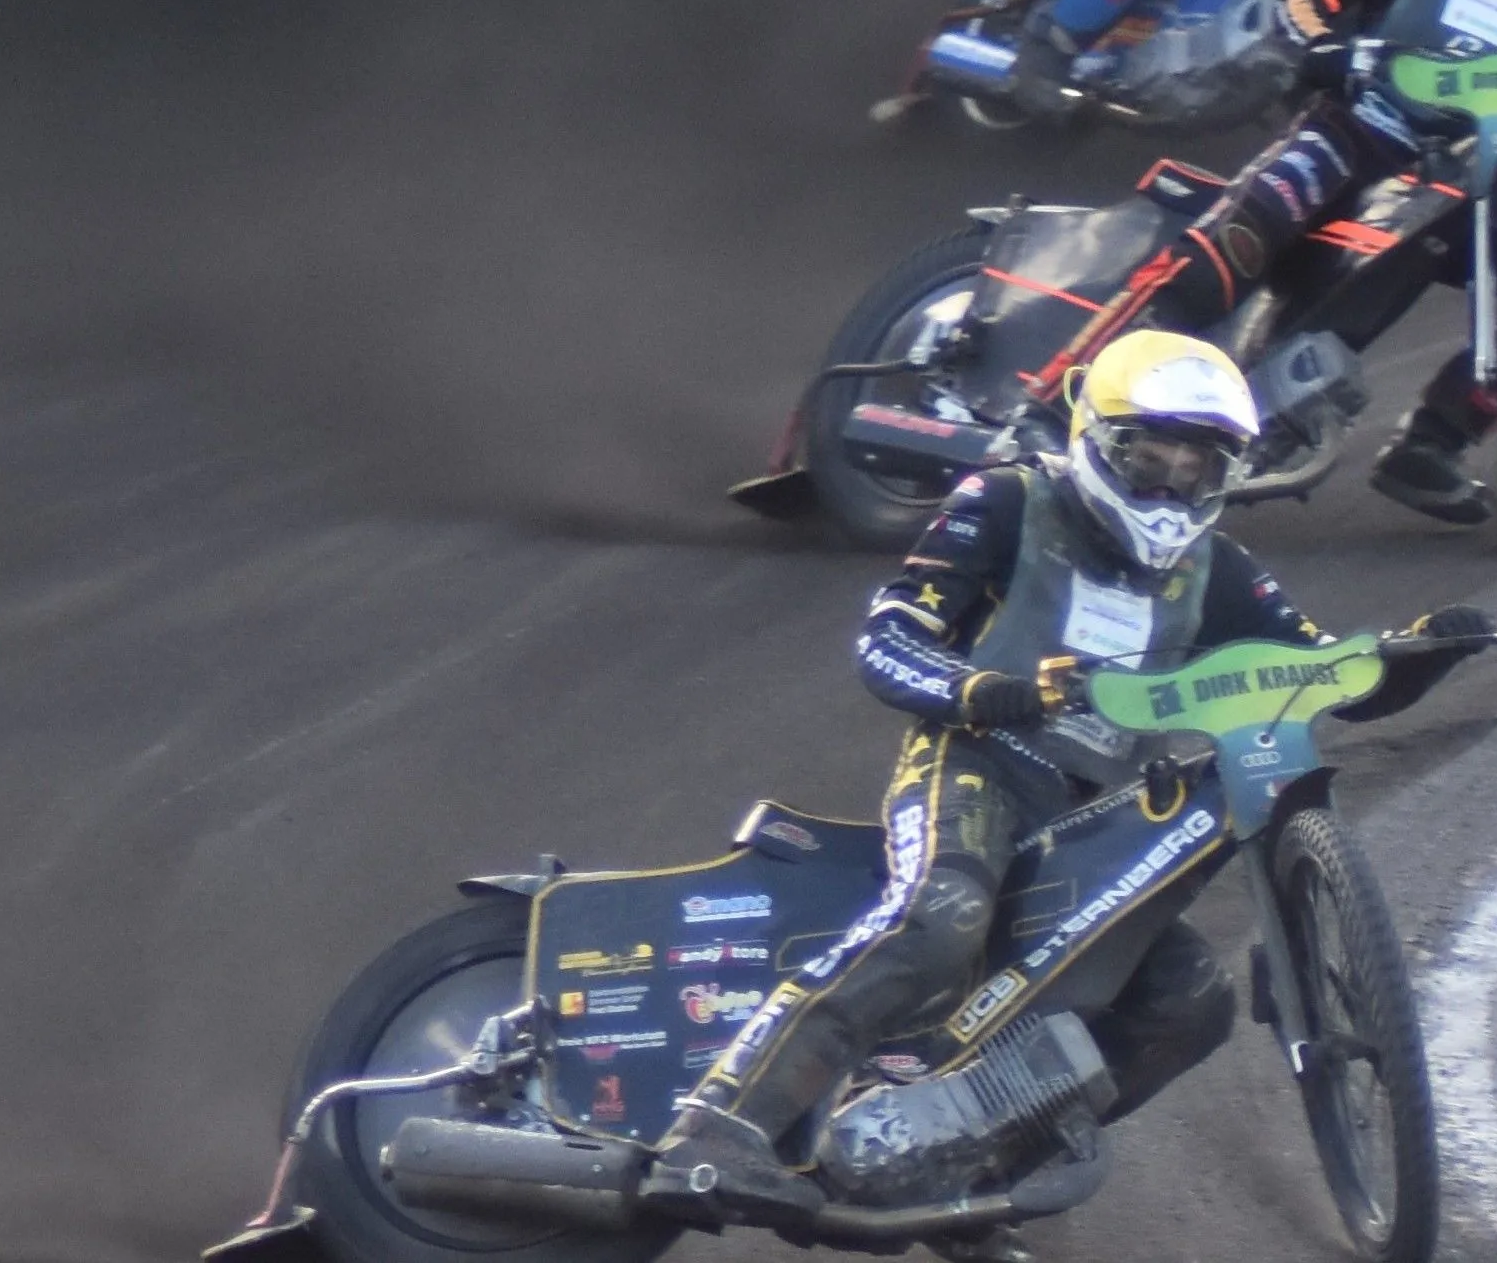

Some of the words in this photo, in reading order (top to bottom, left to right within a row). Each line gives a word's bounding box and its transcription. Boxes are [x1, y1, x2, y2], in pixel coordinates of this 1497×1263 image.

[1192, 670, 1252, 703] DIRK
[1255, 662, 1340, 692] KRAUSE
[1024, 809, 1216, 968] STERNBERG
[959, 974, 1017, 1034] JCB
